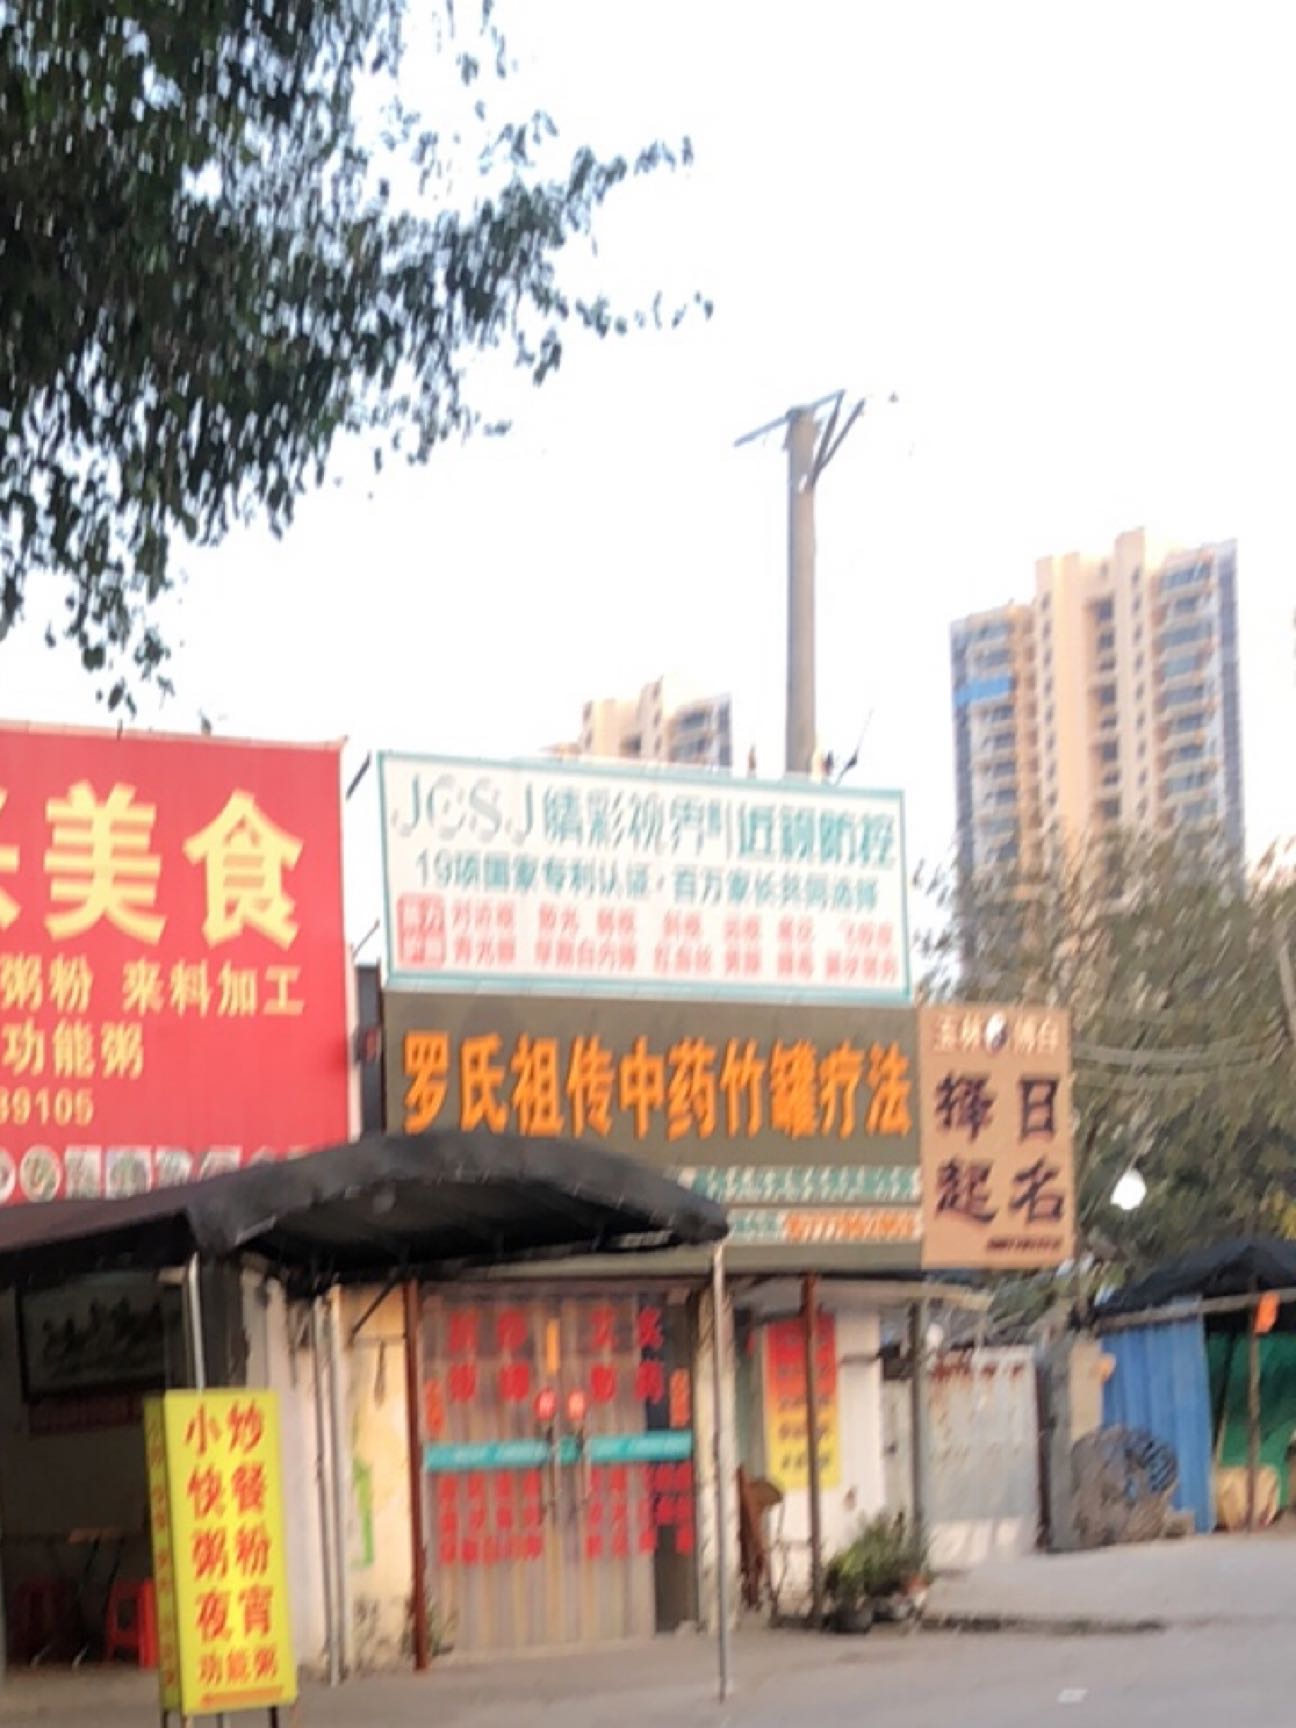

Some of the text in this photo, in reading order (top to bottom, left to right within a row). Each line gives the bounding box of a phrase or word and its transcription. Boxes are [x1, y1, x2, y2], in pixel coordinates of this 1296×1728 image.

[121, 955, 306, 1020] 来料加工
[2, 1016, 145, 1080] 功能粥
[403, 1030, 912, 1142] 罗氏祖传中药竹罐疗法
[184, 1402, 266, 1457] 小炒
[187, 1463, 266, 1519] 快餐
[195, 1585, 274, 1643] 夜宵
